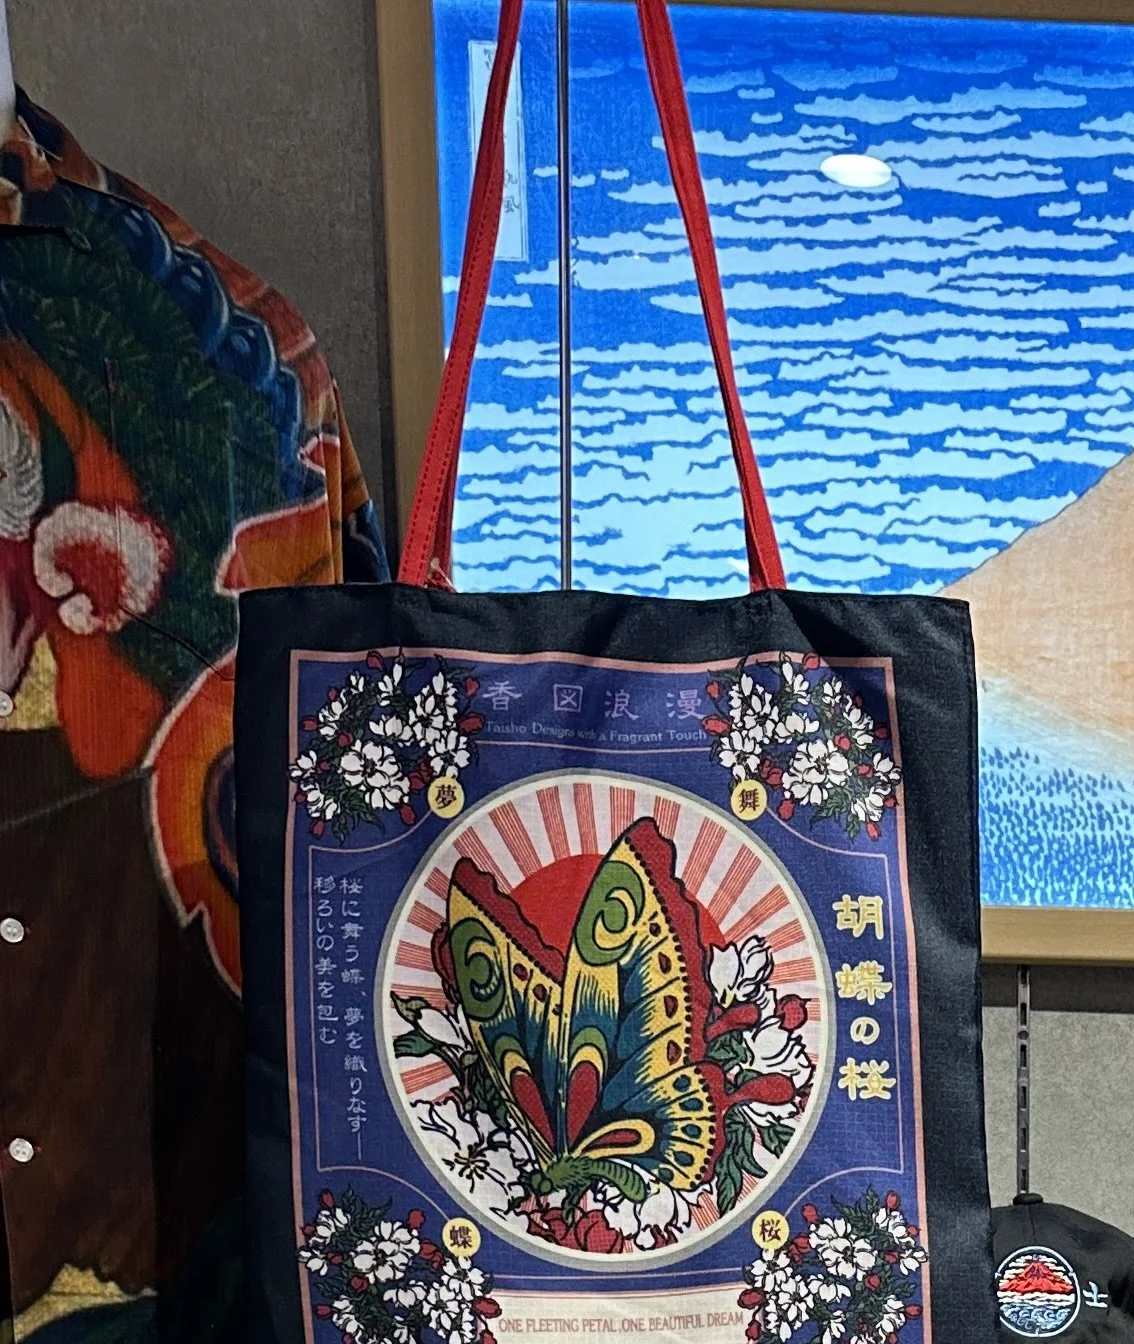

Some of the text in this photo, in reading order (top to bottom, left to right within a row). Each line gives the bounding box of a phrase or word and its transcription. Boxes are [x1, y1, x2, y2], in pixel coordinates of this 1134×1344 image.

[610, 731, 663, 744] Fragrant
[668, 729, 708, 741] Touch
[834, 893, 895, 1102] 胡蝶の桜
[449, 1225, 473, 1248] 蝶
[759, 1217, 782, 1241] 桜
[499, 1318, 524, 1333] ONE
[526, 1317, 579, 1333] FLEETING
[650, 1314, 706, 1331] BEAUTIFUL
[708, 1311, 744, 1327] DREAM
